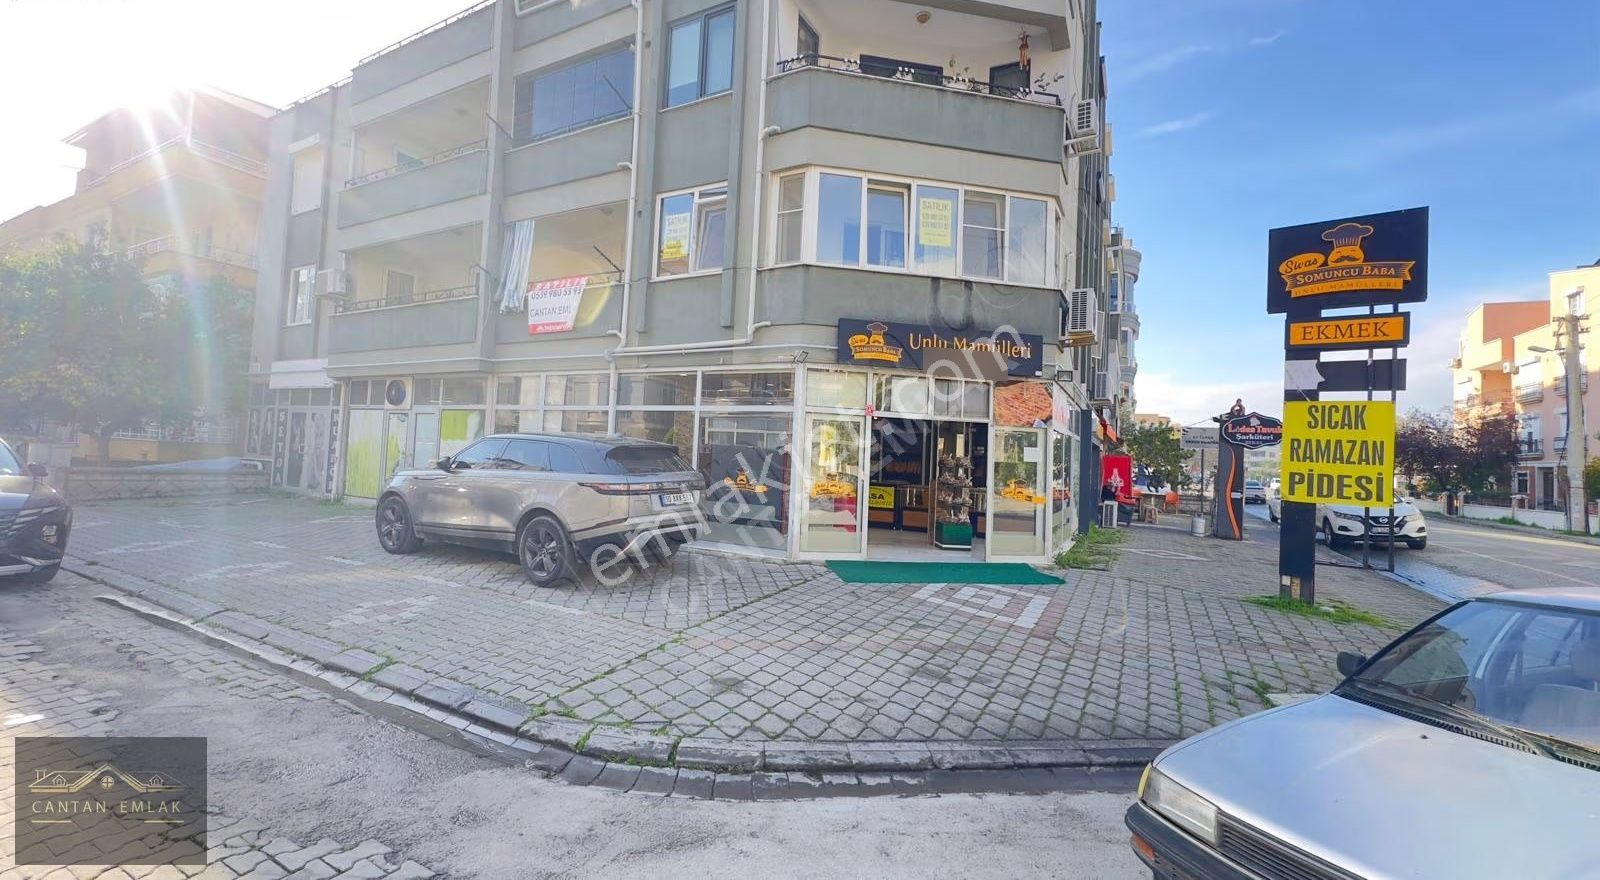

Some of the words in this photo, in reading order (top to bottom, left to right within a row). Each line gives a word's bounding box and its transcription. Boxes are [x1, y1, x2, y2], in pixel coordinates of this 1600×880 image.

[1284, 257, 1318, 274] Sivas
[1296, 267, 1359, 285] SOMUNCU
[1362, 265, 1396, 276] BABA
[529, 306, 557, 318] CANTAN
[1301, 321, 1390, 341] EKMEK
[1307, 404, 1367, 430] SICAK
[1290, 438, 1385, 466] RAMAZAN
[1288, 469, 1384, 502] PİDESİ
